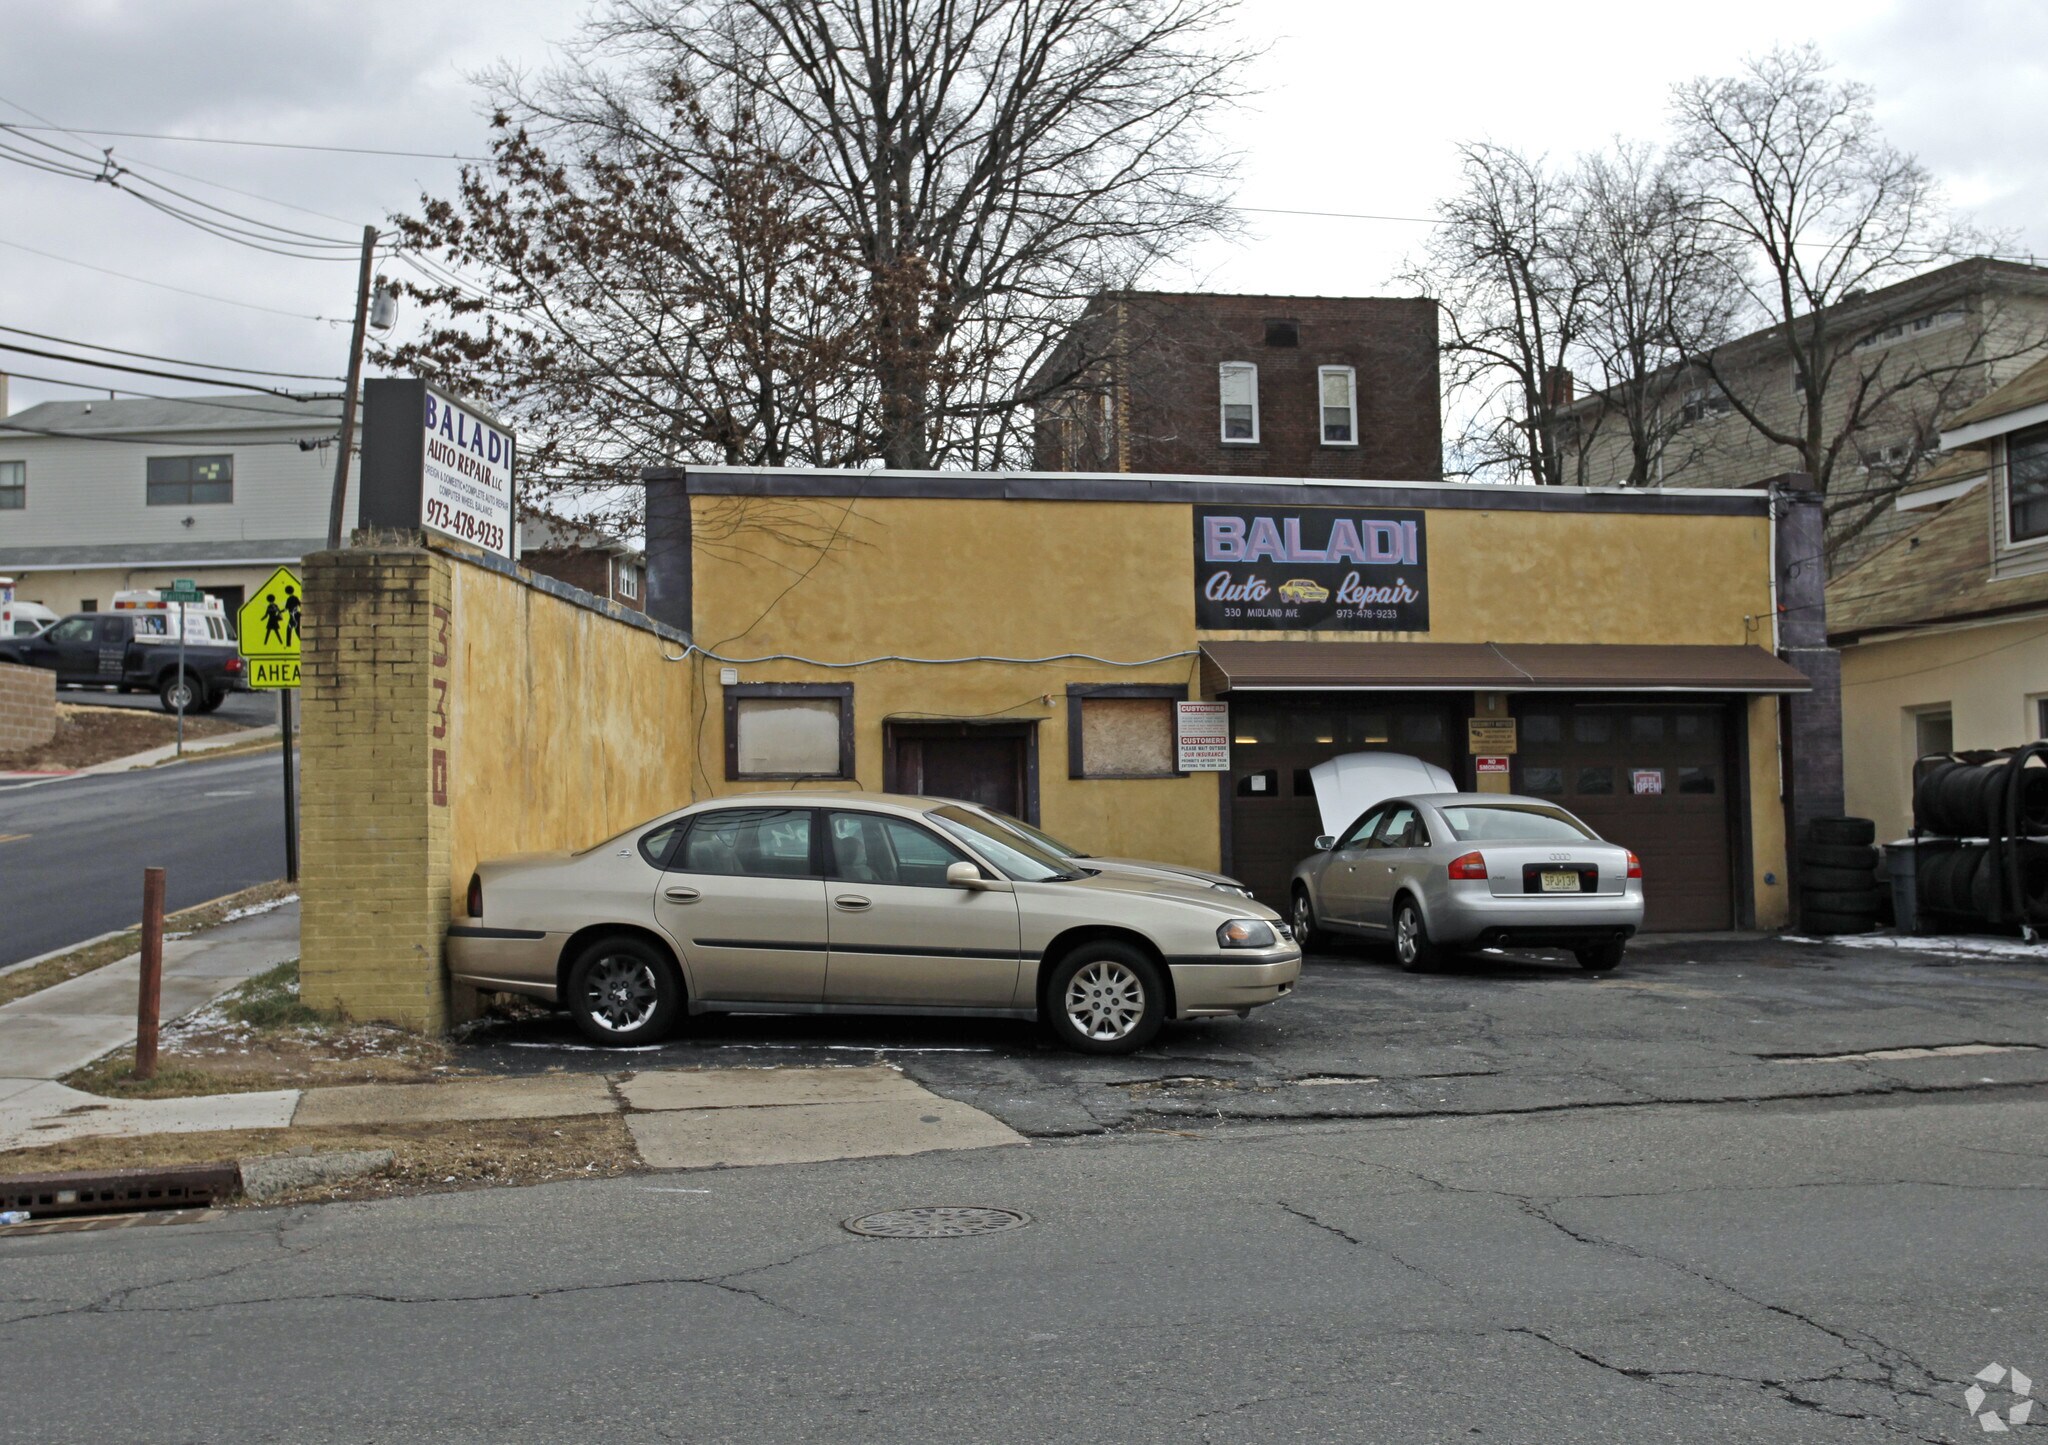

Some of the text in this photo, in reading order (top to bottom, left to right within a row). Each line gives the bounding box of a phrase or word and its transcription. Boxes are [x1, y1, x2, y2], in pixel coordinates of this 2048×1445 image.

[425, 394, 510, 470] BALADI
[427, 438, 503, 492] AUTO REPAIR LLC
[424, 463, 439, 479] OREIGN
[443, 472, 463, 490] DOMESTIC
[465, 483, 485, 501] COMPLETE
[485, 493, 496, 505] AUTO
[495, 497, 509, 511] REPAIR
[439, 484, 493, 518] COMPUTER WHEEL BALANCE
[426, 497, 504, 551] 973-478-9233
[1203, 515, 1418, 565] BALADI
[1205, 570, 1419, 610] Auto Repair
[1224, 608, 1242, 618] 330
[1247, 608, 1283, 618] MIDLAND
[1336, 609, 1398, 619] 973-478-9233
[257, 664, 300, 682] AHEA
[1637, 782, 1661, 793] OPEN
